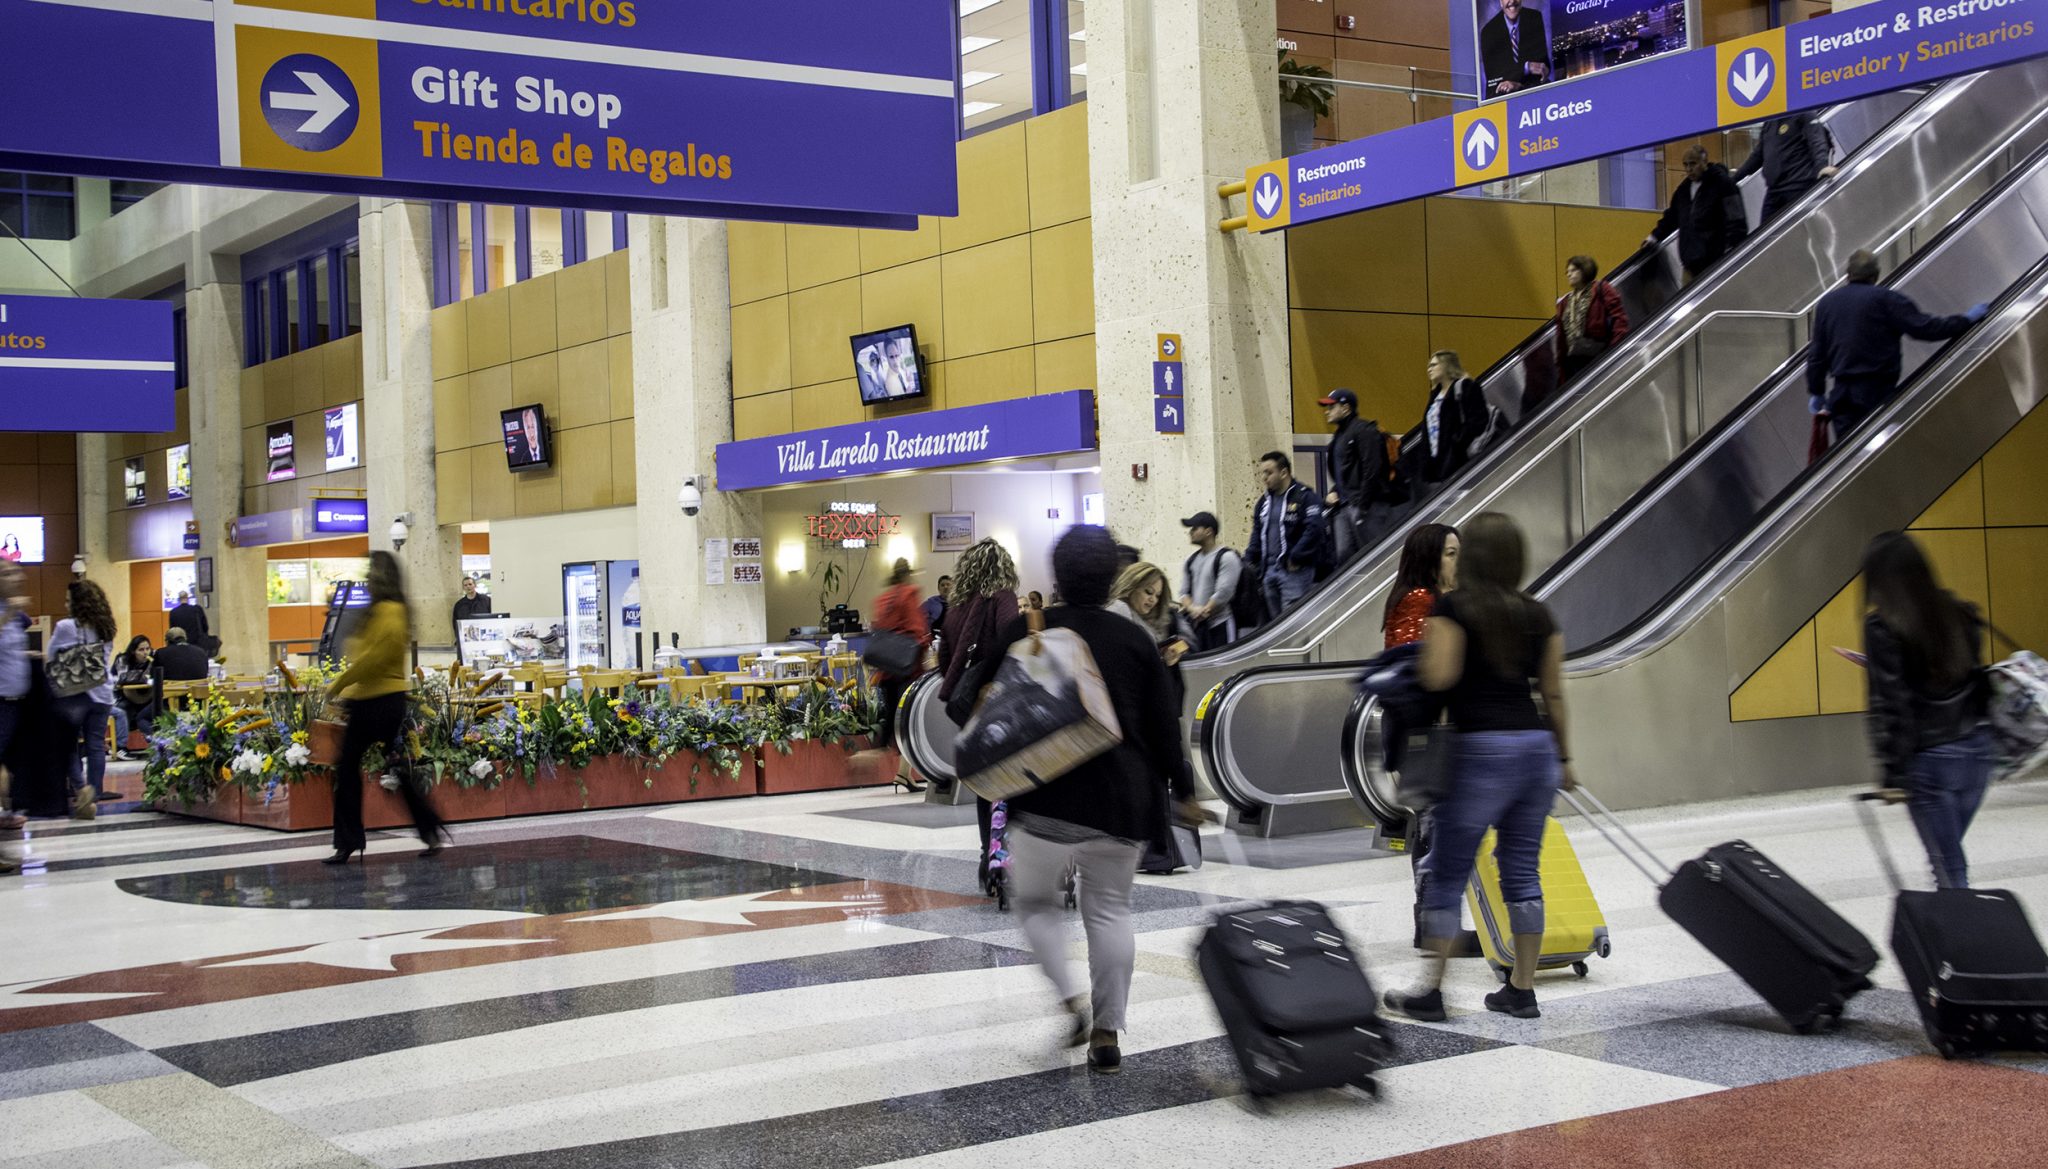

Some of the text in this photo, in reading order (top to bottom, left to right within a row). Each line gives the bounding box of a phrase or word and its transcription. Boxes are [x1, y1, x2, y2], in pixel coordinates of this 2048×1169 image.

[1277, 38, 1297, 51] tion
[1800, 0, 2022, 58] Elevator & Restro
[1801, 20, 2035, 90] Elevador y Sanitarios
[411, 66, 622, 129] Gift Shop
[1518, 99, 1592, 129] All Gates
[413, 120, 732, 184] Tienda de Regalos
[1519, 134, 1559, 157] Salas
[1297, 156, 1366, 184] Restrooms
[1298, 182, 1361, 208] Sanitarios
[777, 425, 990, 474] Villa Laredo Restaurant
